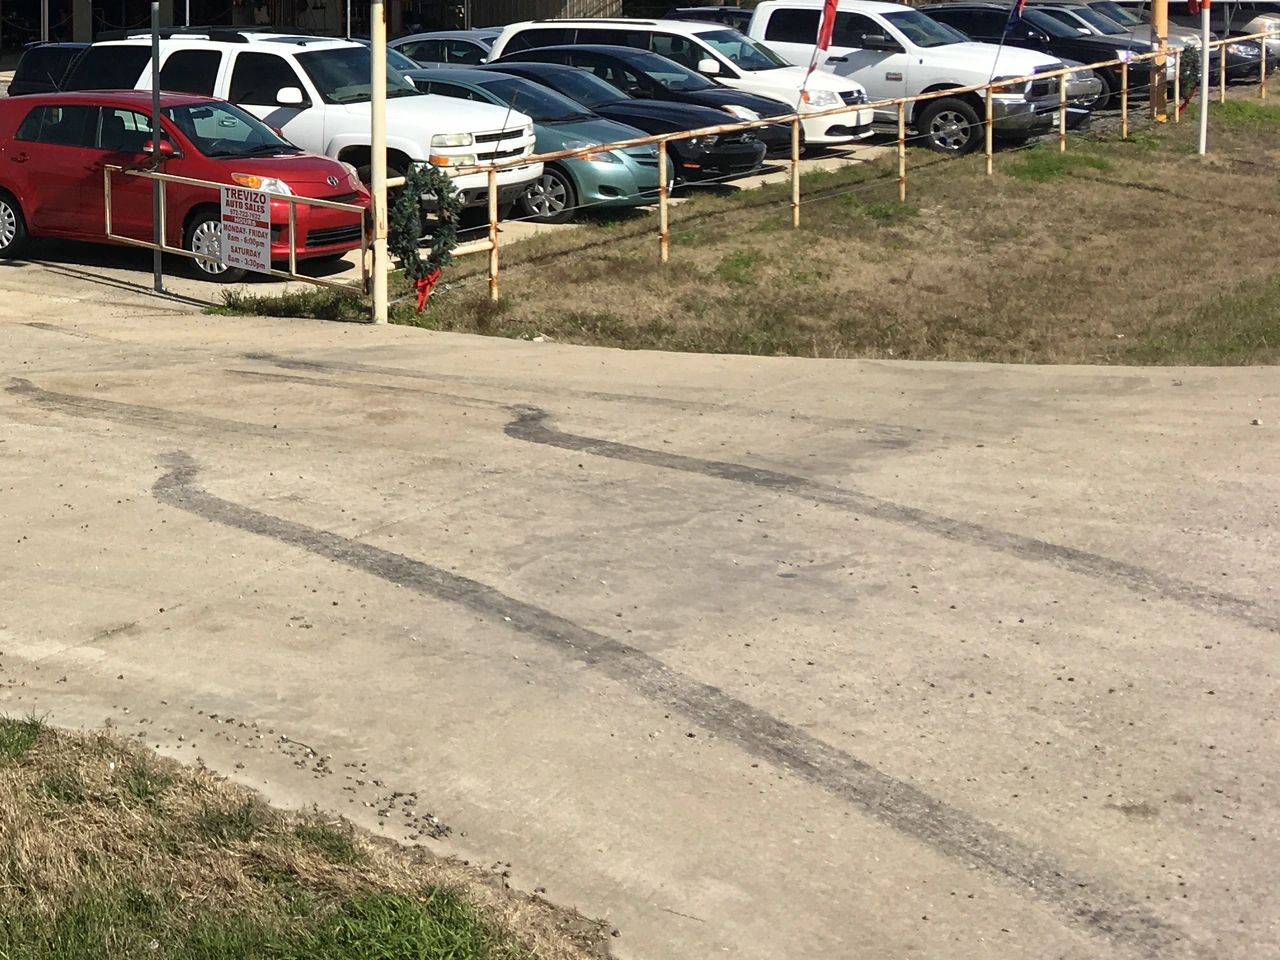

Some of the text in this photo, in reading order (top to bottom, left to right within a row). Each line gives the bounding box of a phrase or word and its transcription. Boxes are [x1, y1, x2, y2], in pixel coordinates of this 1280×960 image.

[225, 187, 266, 204] TREVIZO
[225, 199, 265, 214] AUTO SALES
[234, 216, 257, 227] HOURS
[249, 229, 268, 239] FRIDAY
[231, 245, 261, 258] SATURDAY
